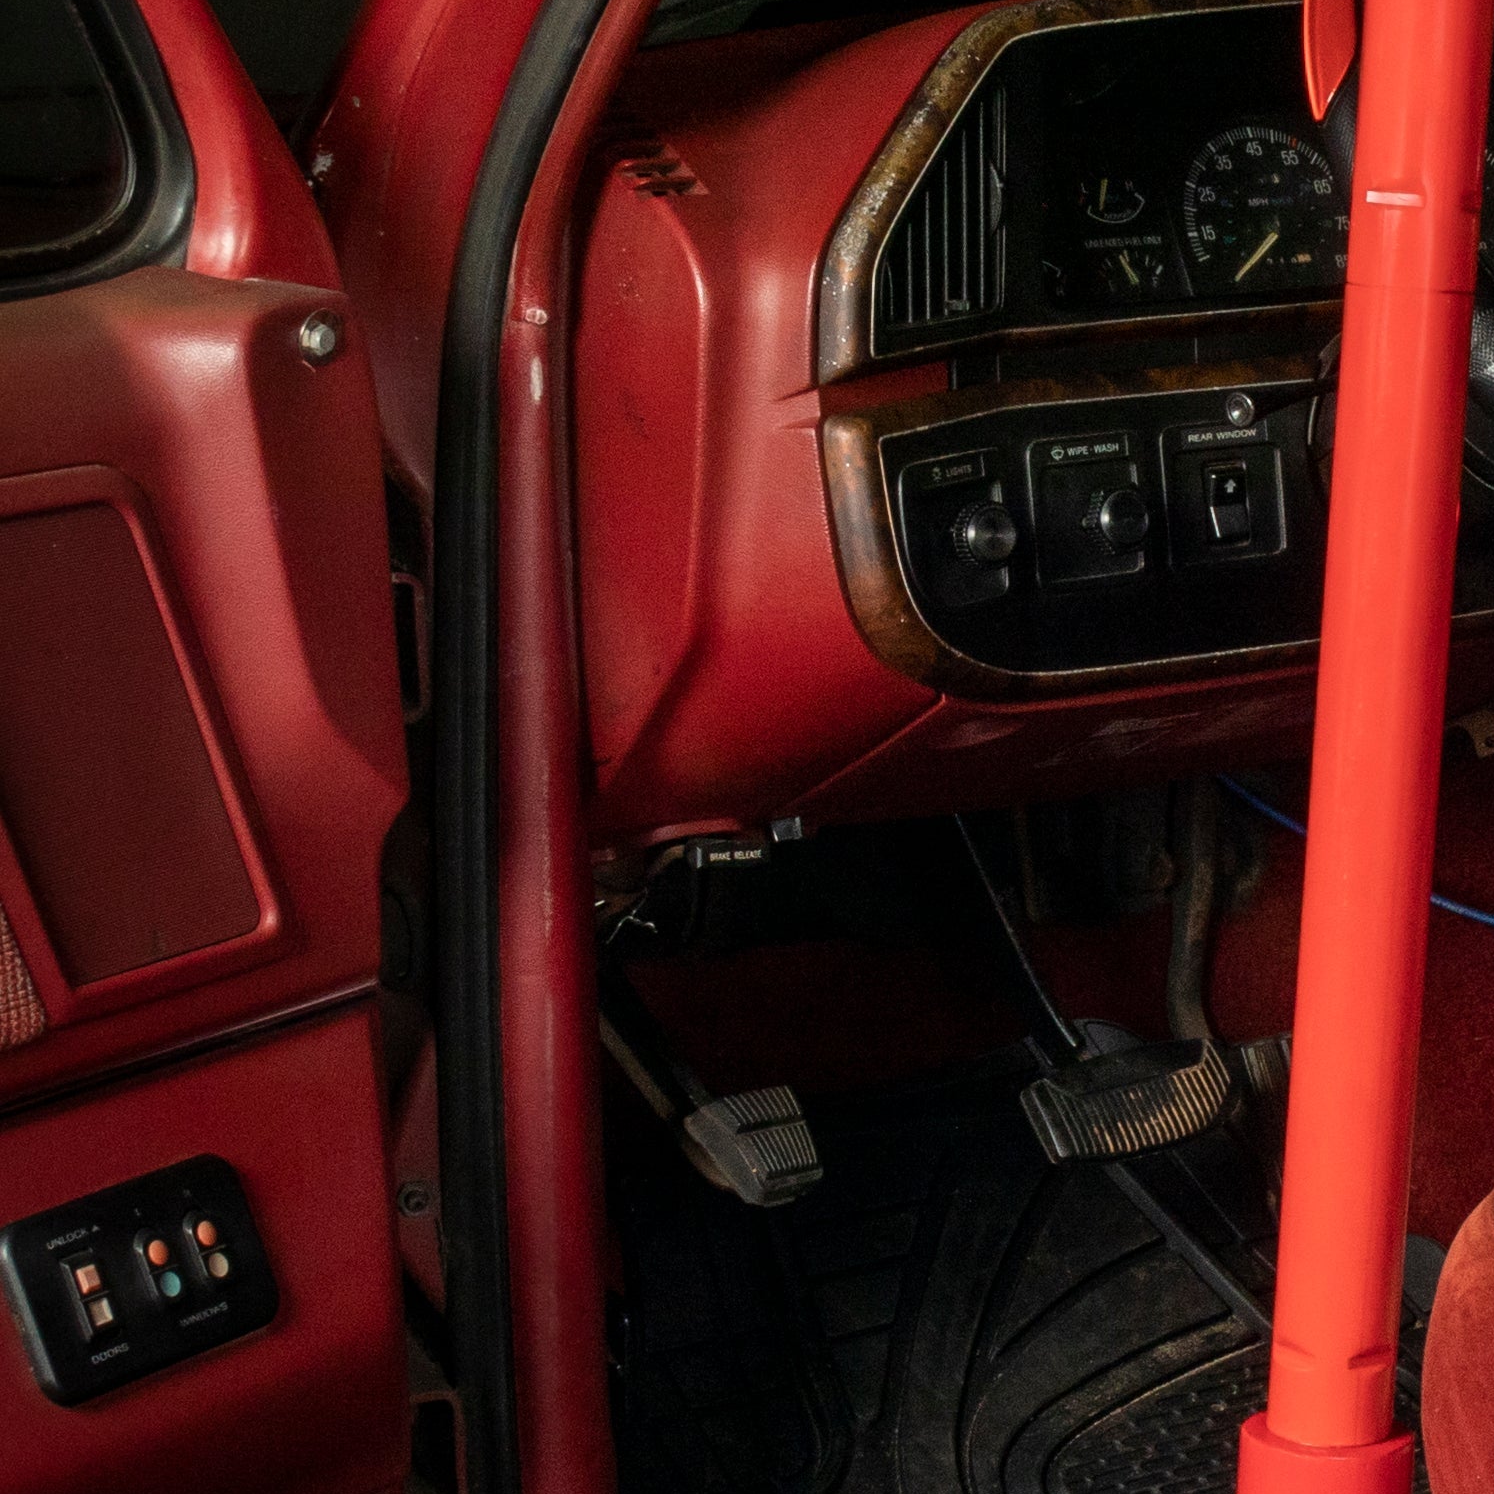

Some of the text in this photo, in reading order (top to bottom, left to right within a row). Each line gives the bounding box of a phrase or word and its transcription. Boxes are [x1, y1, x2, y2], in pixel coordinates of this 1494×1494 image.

[1245, 140, 1263, 157] 45
[1214, 154, 1233, 171] 35
[1280, 149, 1299, 166] 55
[1198, 186, 1216, 202] 25
[1313, 179, 1332, 195] 65
[1334, 215, 1349, 231] 75
[1200, 224, 1216, 240] 15
[1188, 428, 1257, 442] REAR WINDOW
[709, 849, 762, 861] BRAKE RELEASE
[46, 1228, 89, 1251] UNLOCK
[91, 1342, 130, 1365] DOORS
